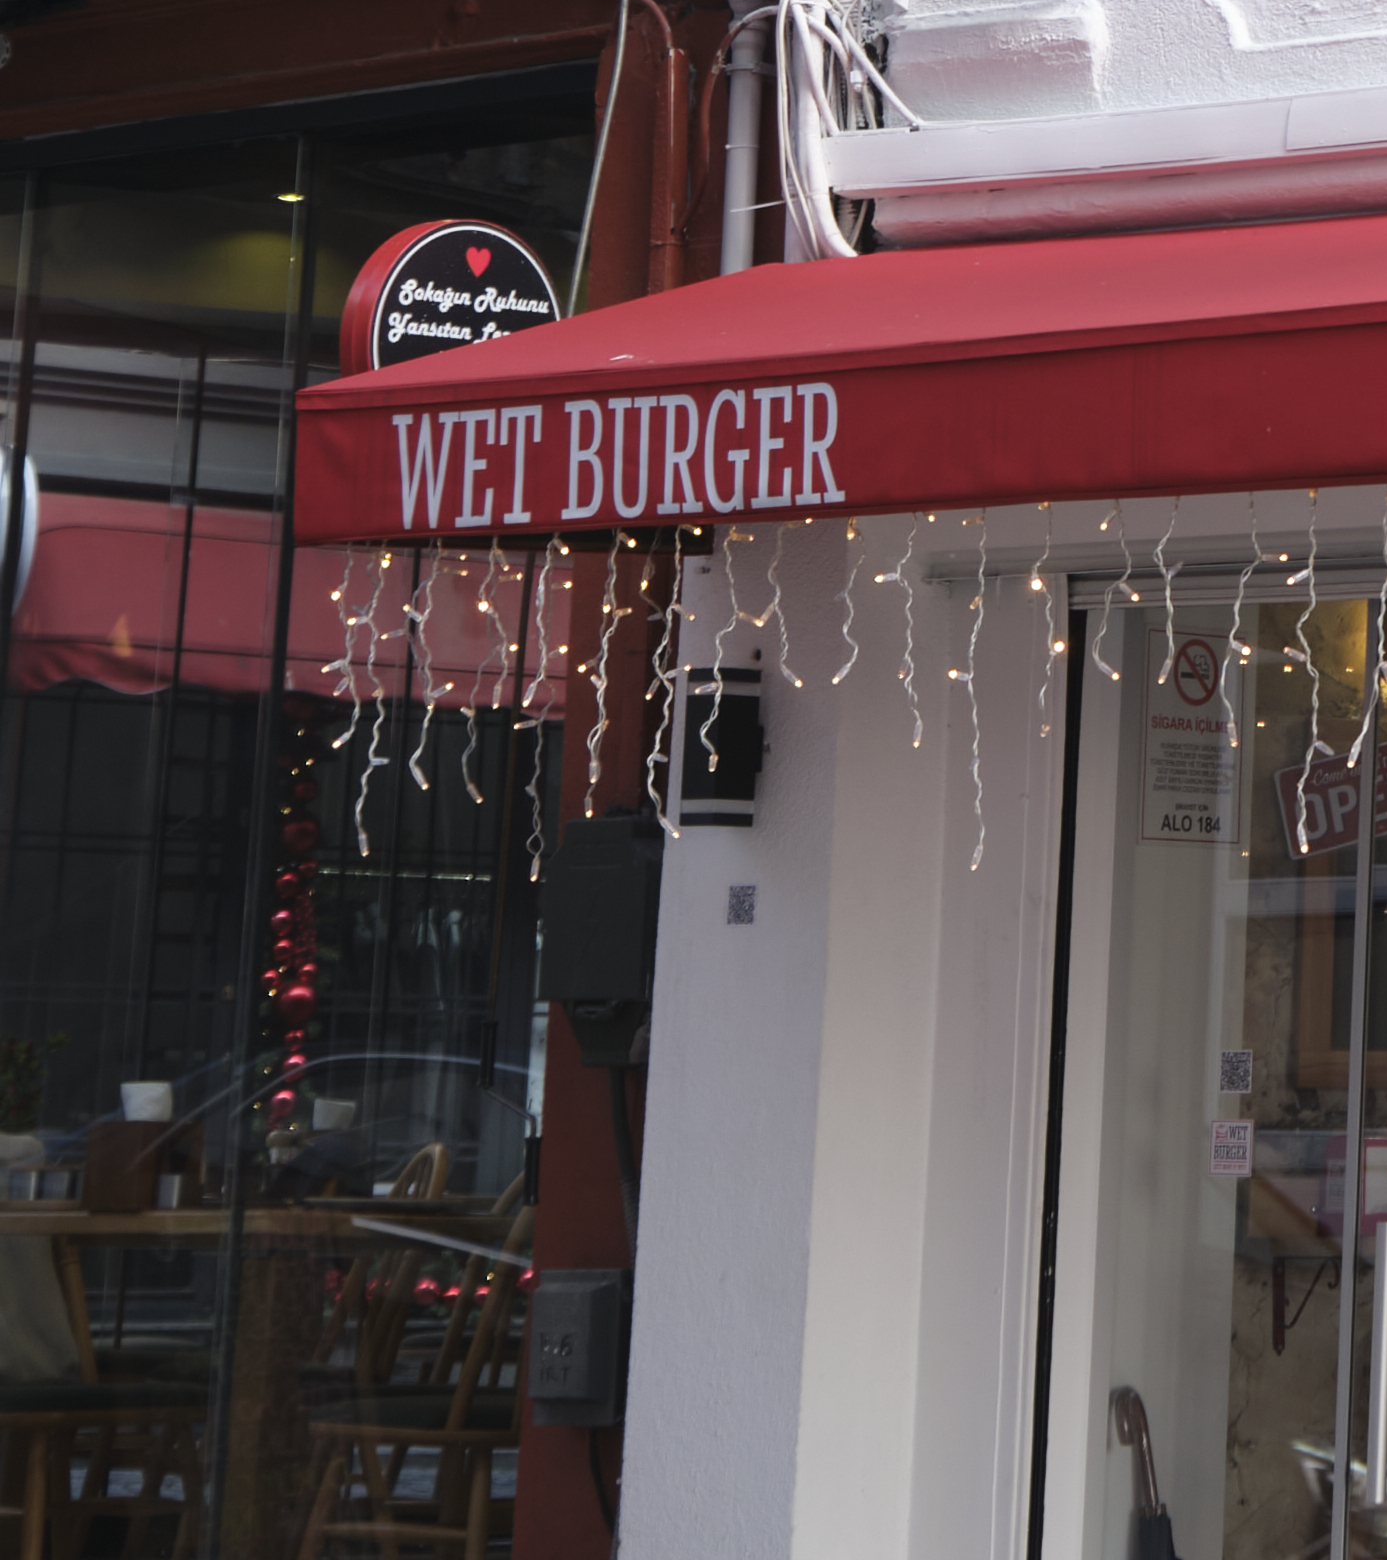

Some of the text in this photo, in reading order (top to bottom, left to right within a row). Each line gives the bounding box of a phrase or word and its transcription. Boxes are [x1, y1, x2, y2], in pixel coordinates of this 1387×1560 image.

[474, 287, 549, 313] Ruhunu
[388, 312, 472, 343] Yansıtan
[392, 382, 846, 530] WET BURGER
[1195, 716, 1238, 734] İÇİLM
[1161, 813, 1221, 833] ALO 184
[1228, 1126, 1248, 1141] WET
[1213, 1145, 1247, 1160] BURGER
